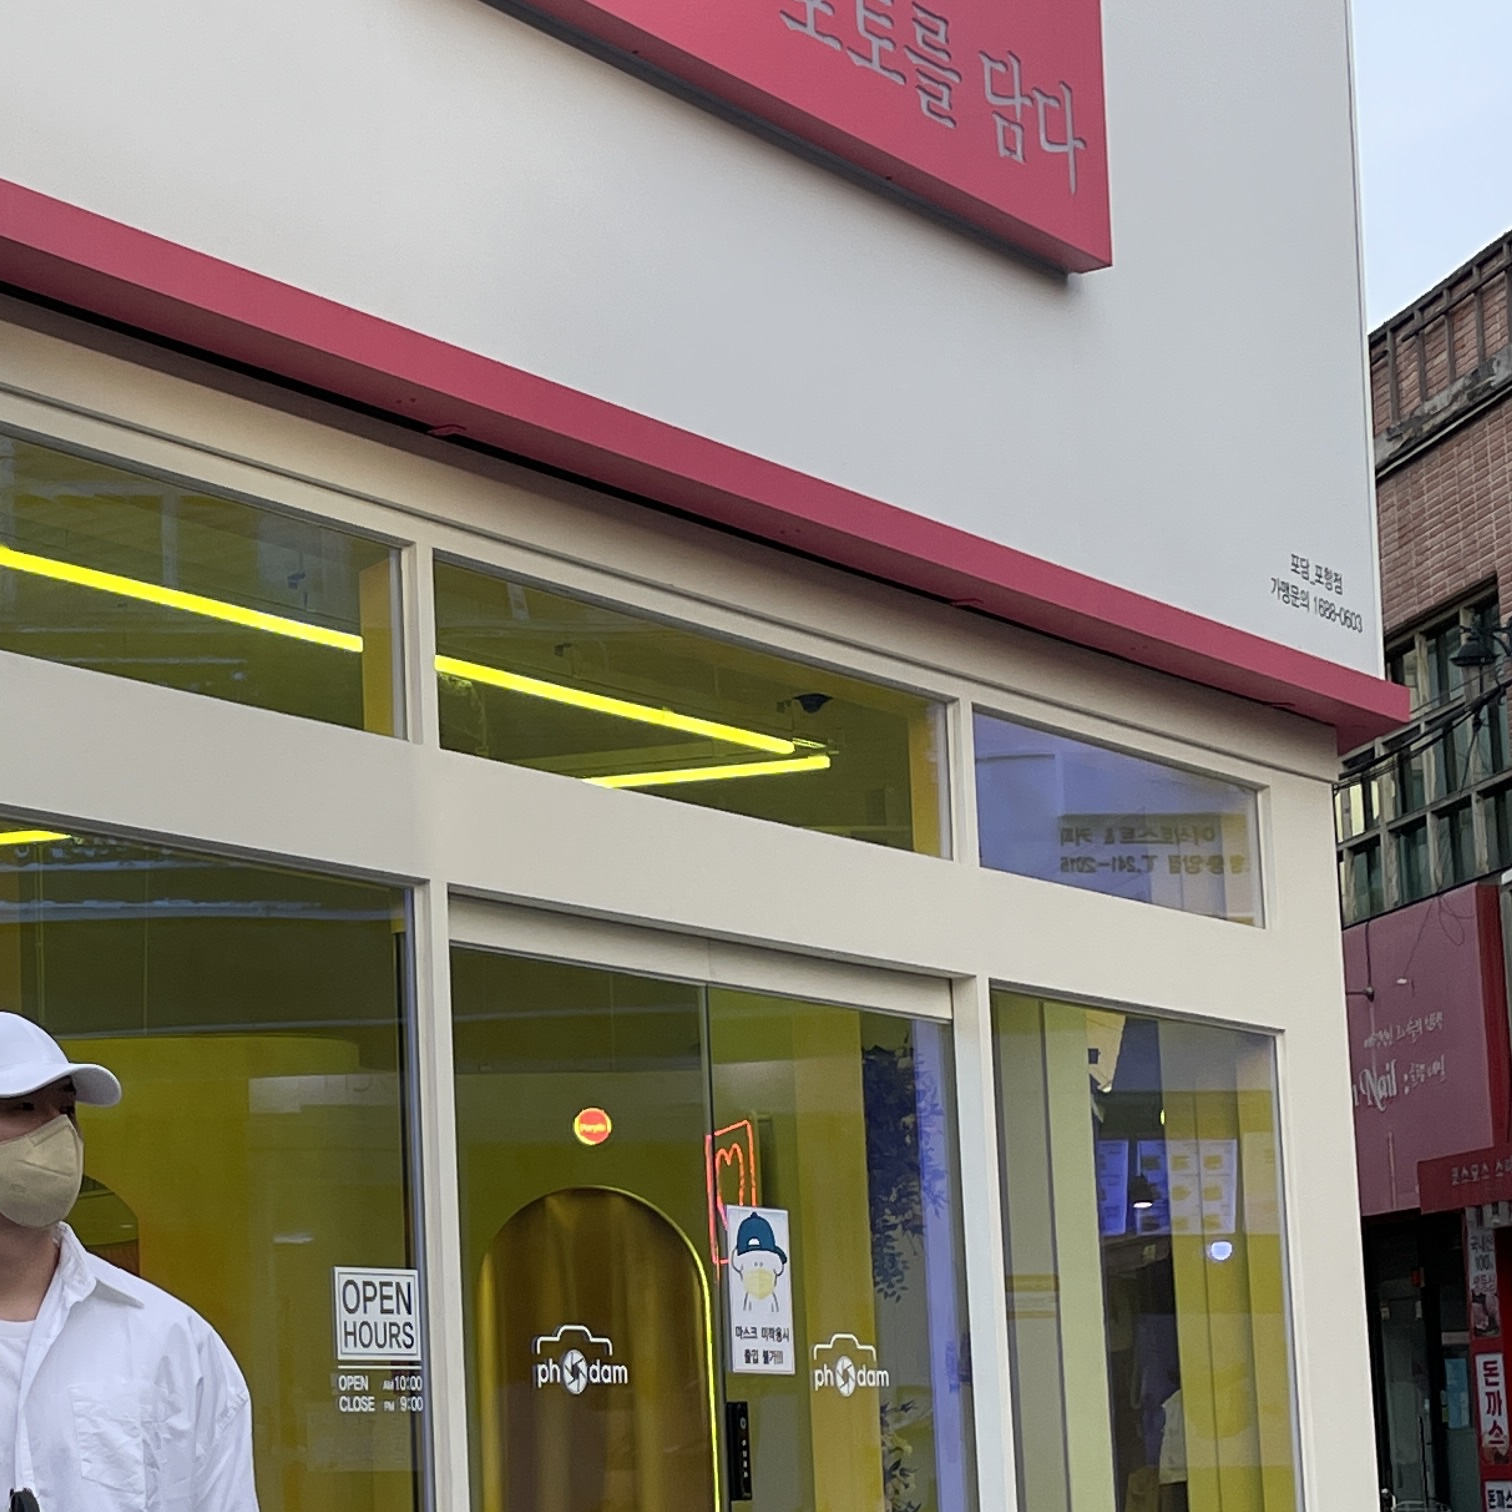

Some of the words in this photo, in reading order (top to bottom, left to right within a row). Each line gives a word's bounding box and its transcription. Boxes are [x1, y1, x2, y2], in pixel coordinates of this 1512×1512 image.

[978, 51, 1087, 195] 담다
[1313, 596, 1363, 633] 1688-0603
[342, 1279, 413, 1315] OPEN
[343, 1321, 415, 1349] HOURS
[339, 1375, 369, 1391] OPEN
[394, 1375, 423, 1391] 10:00
[339, 1396, 375, 1412] CLOSE
[400, 1396, 424, 1412] 9:00
[1484, 1360, 1505, 1445] 돈까스
